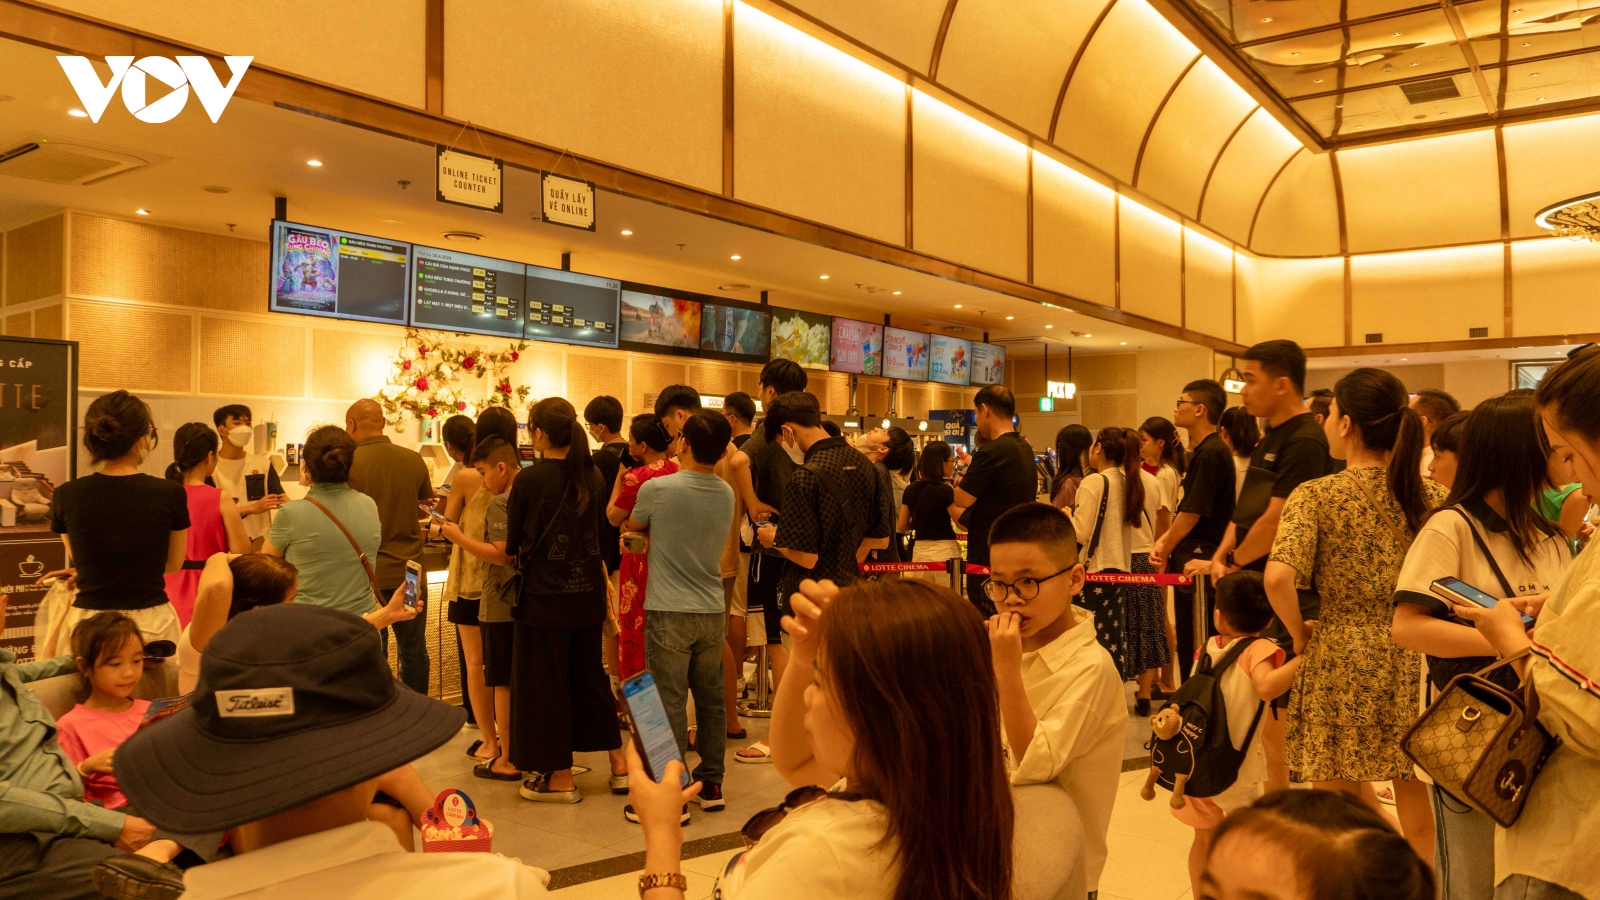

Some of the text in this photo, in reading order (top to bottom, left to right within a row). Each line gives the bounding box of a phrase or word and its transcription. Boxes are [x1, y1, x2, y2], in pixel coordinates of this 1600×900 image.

[443, 167, 497, 186] ONLINE TICKET
[454, 180, 486, 194] COUNTER
[550, 188, 586, 204] QUẤY LẤY
[561, 201, 588, 217] ONLINE
[838, 326, 859, 341] CRUSH
[9, 357, 33, 368] CẤP
[898, 563, 929, 571] CINEMA
[226, 695, 283, 712] Titleist
[446, 812, 464, 820] CINEMA
[447, 806, 462, 814] LOTTE
